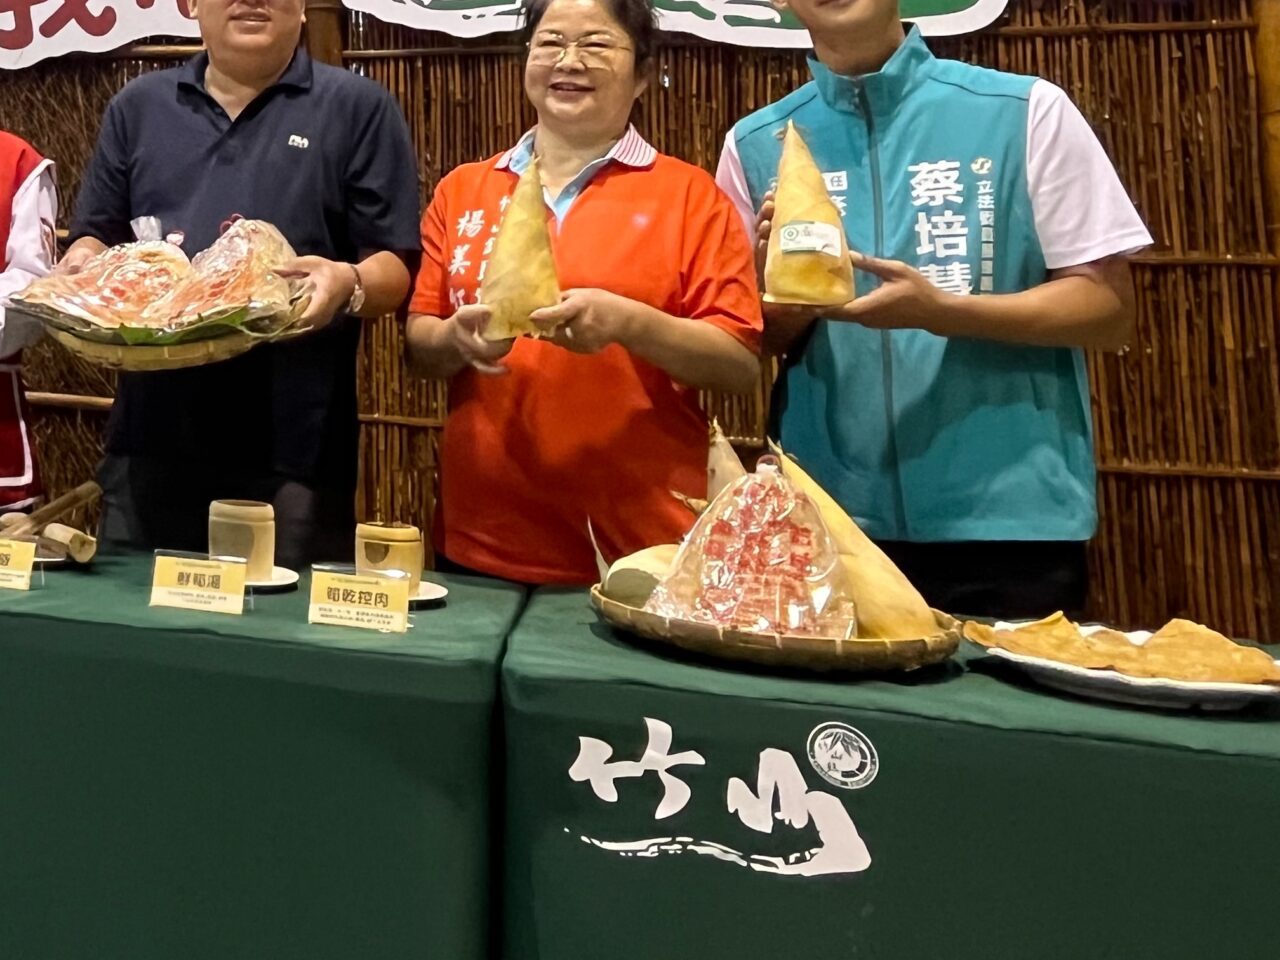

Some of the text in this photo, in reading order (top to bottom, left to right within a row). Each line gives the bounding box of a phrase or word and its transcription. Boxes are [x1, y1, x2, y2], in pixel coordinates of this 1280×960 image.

[908, 160, 973, 295] 蔡培慧
[566, 717, 872, 877] 竹山
